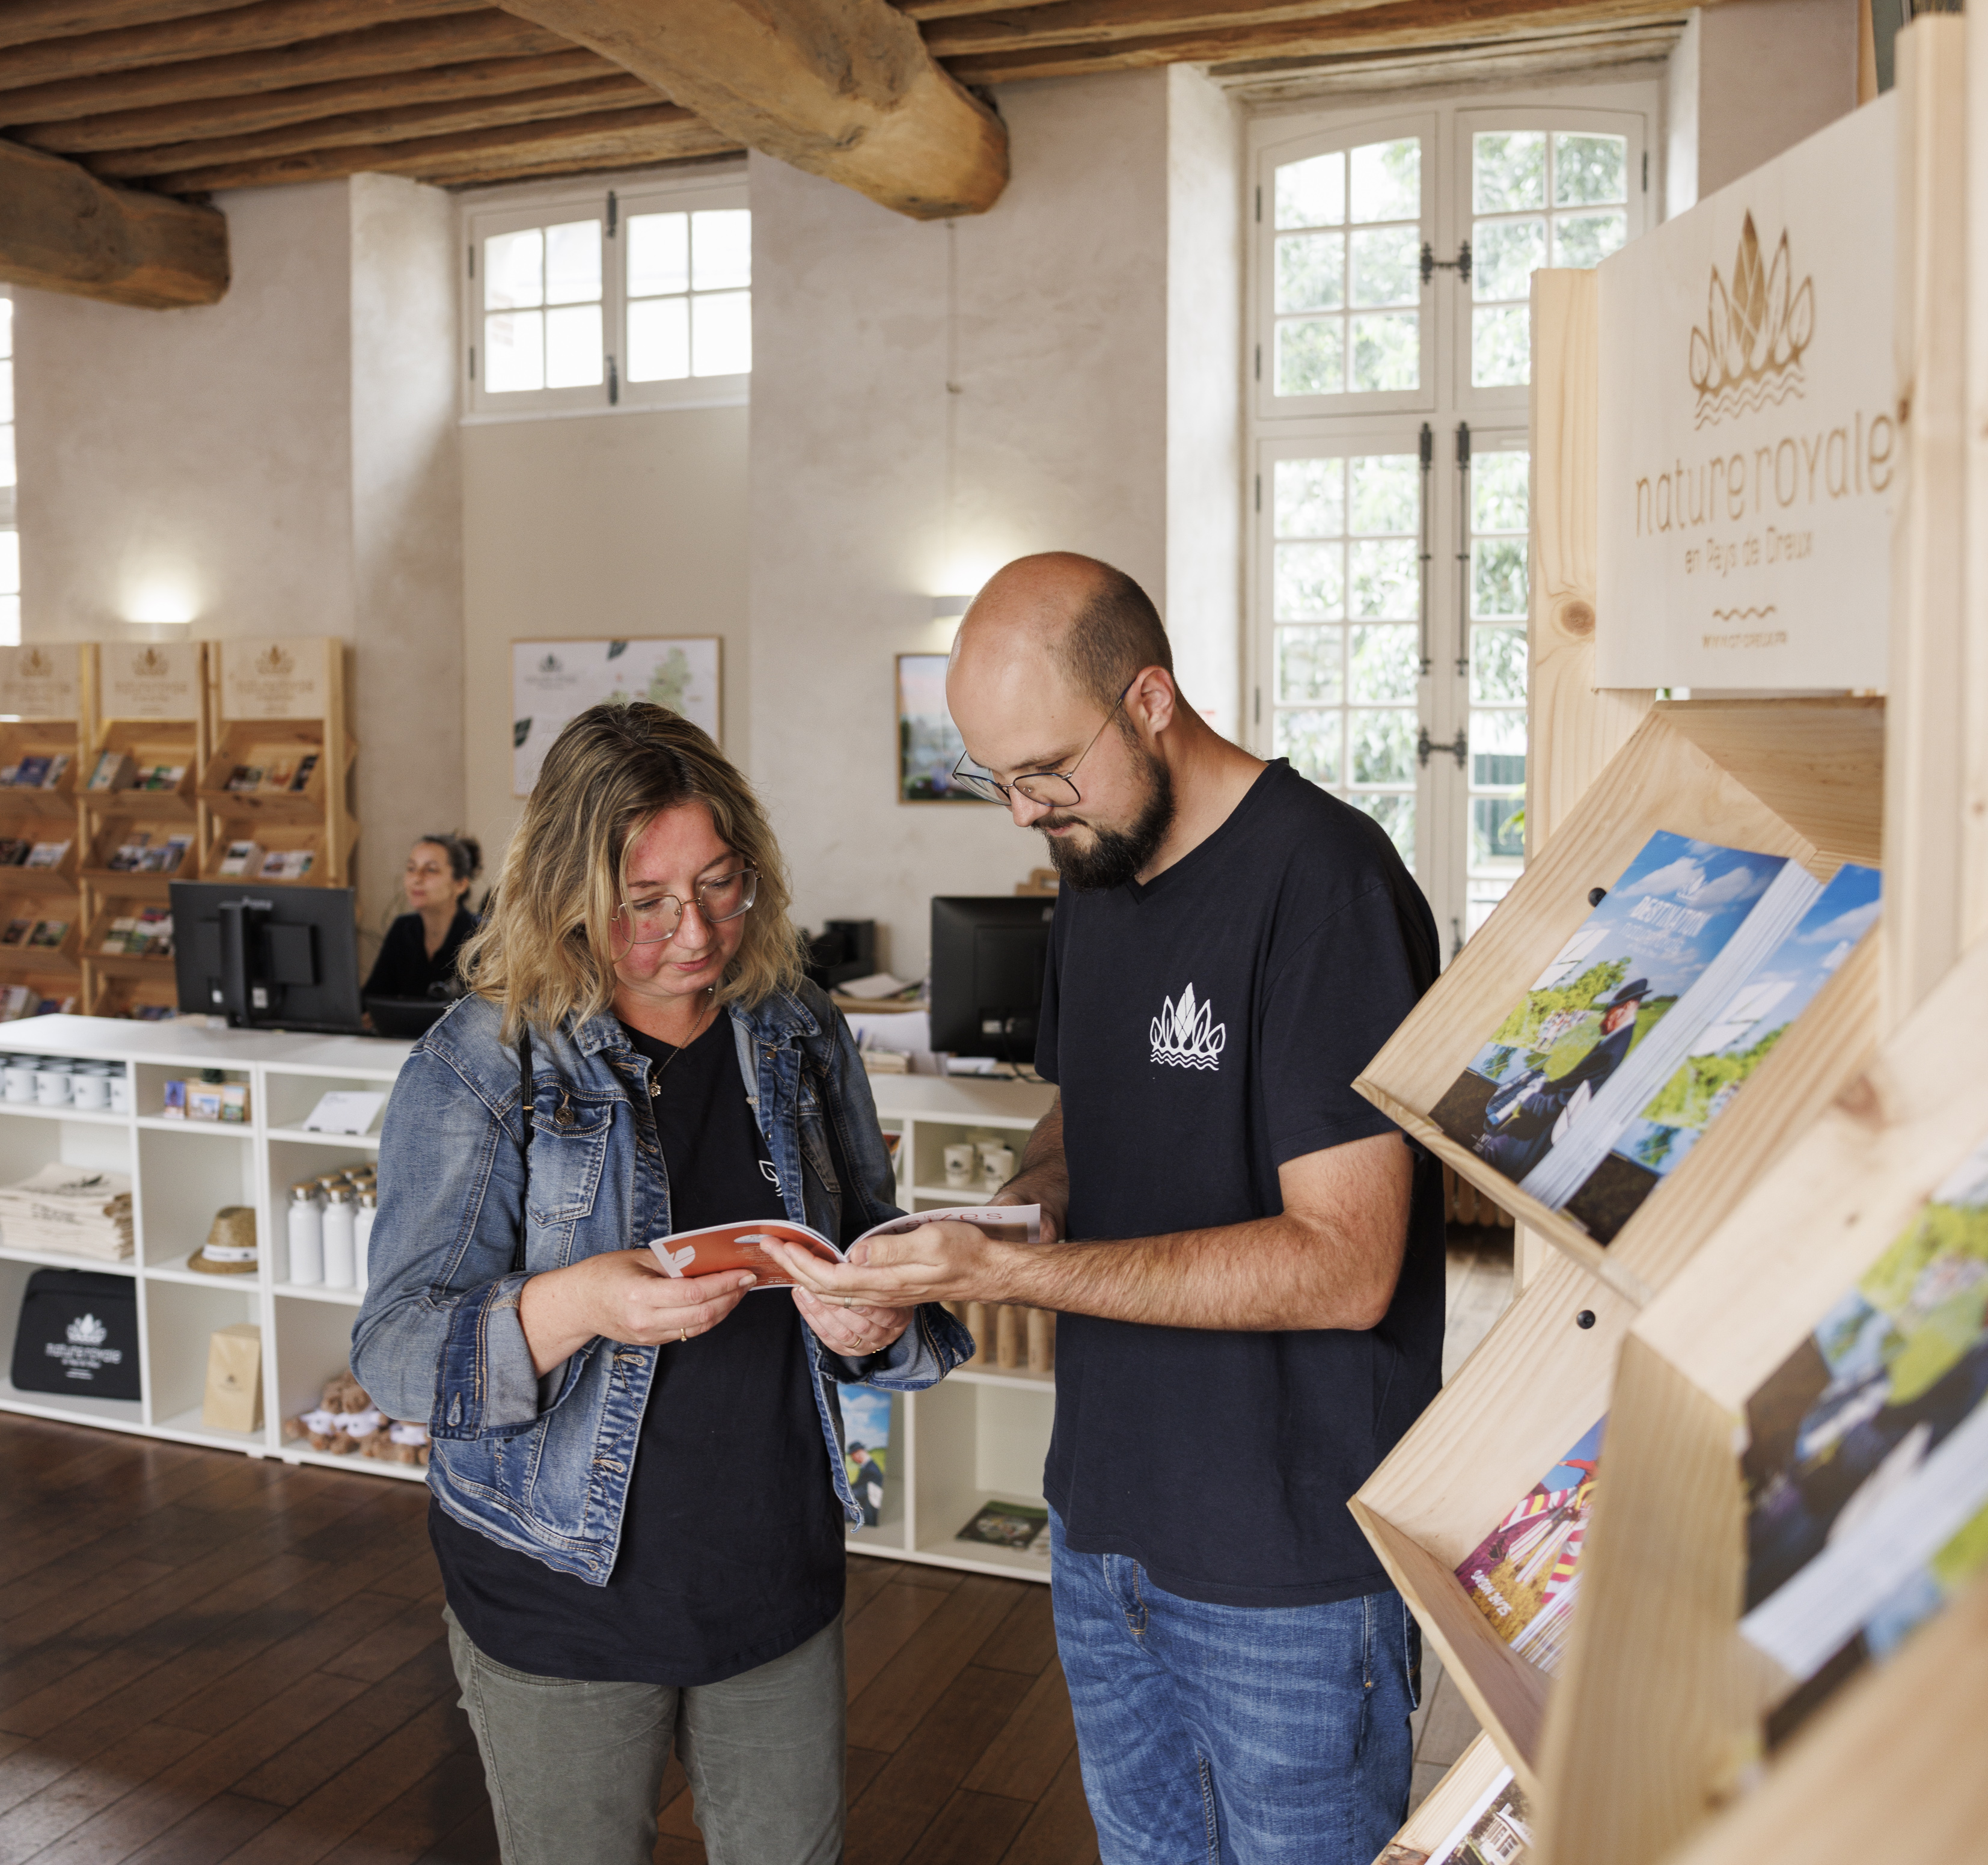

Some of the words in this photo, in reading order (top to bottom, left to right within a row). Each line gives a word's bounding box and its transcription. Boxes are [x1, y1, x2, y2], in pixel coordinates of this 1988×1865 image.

[1636, 453, 1745, 537] nature
[1753, 409, 1895, 513] royale
[1685, 549, 1700, 574] en
[1706, 538, 1736, 578] Pays
[1743, 532, 1760, 567] de
[1766, 525, 1814, 566] Dreux
[1628, 895, 1713, 938] DESTINATION
[1470, 1569, 1496, 1596] SAISON
